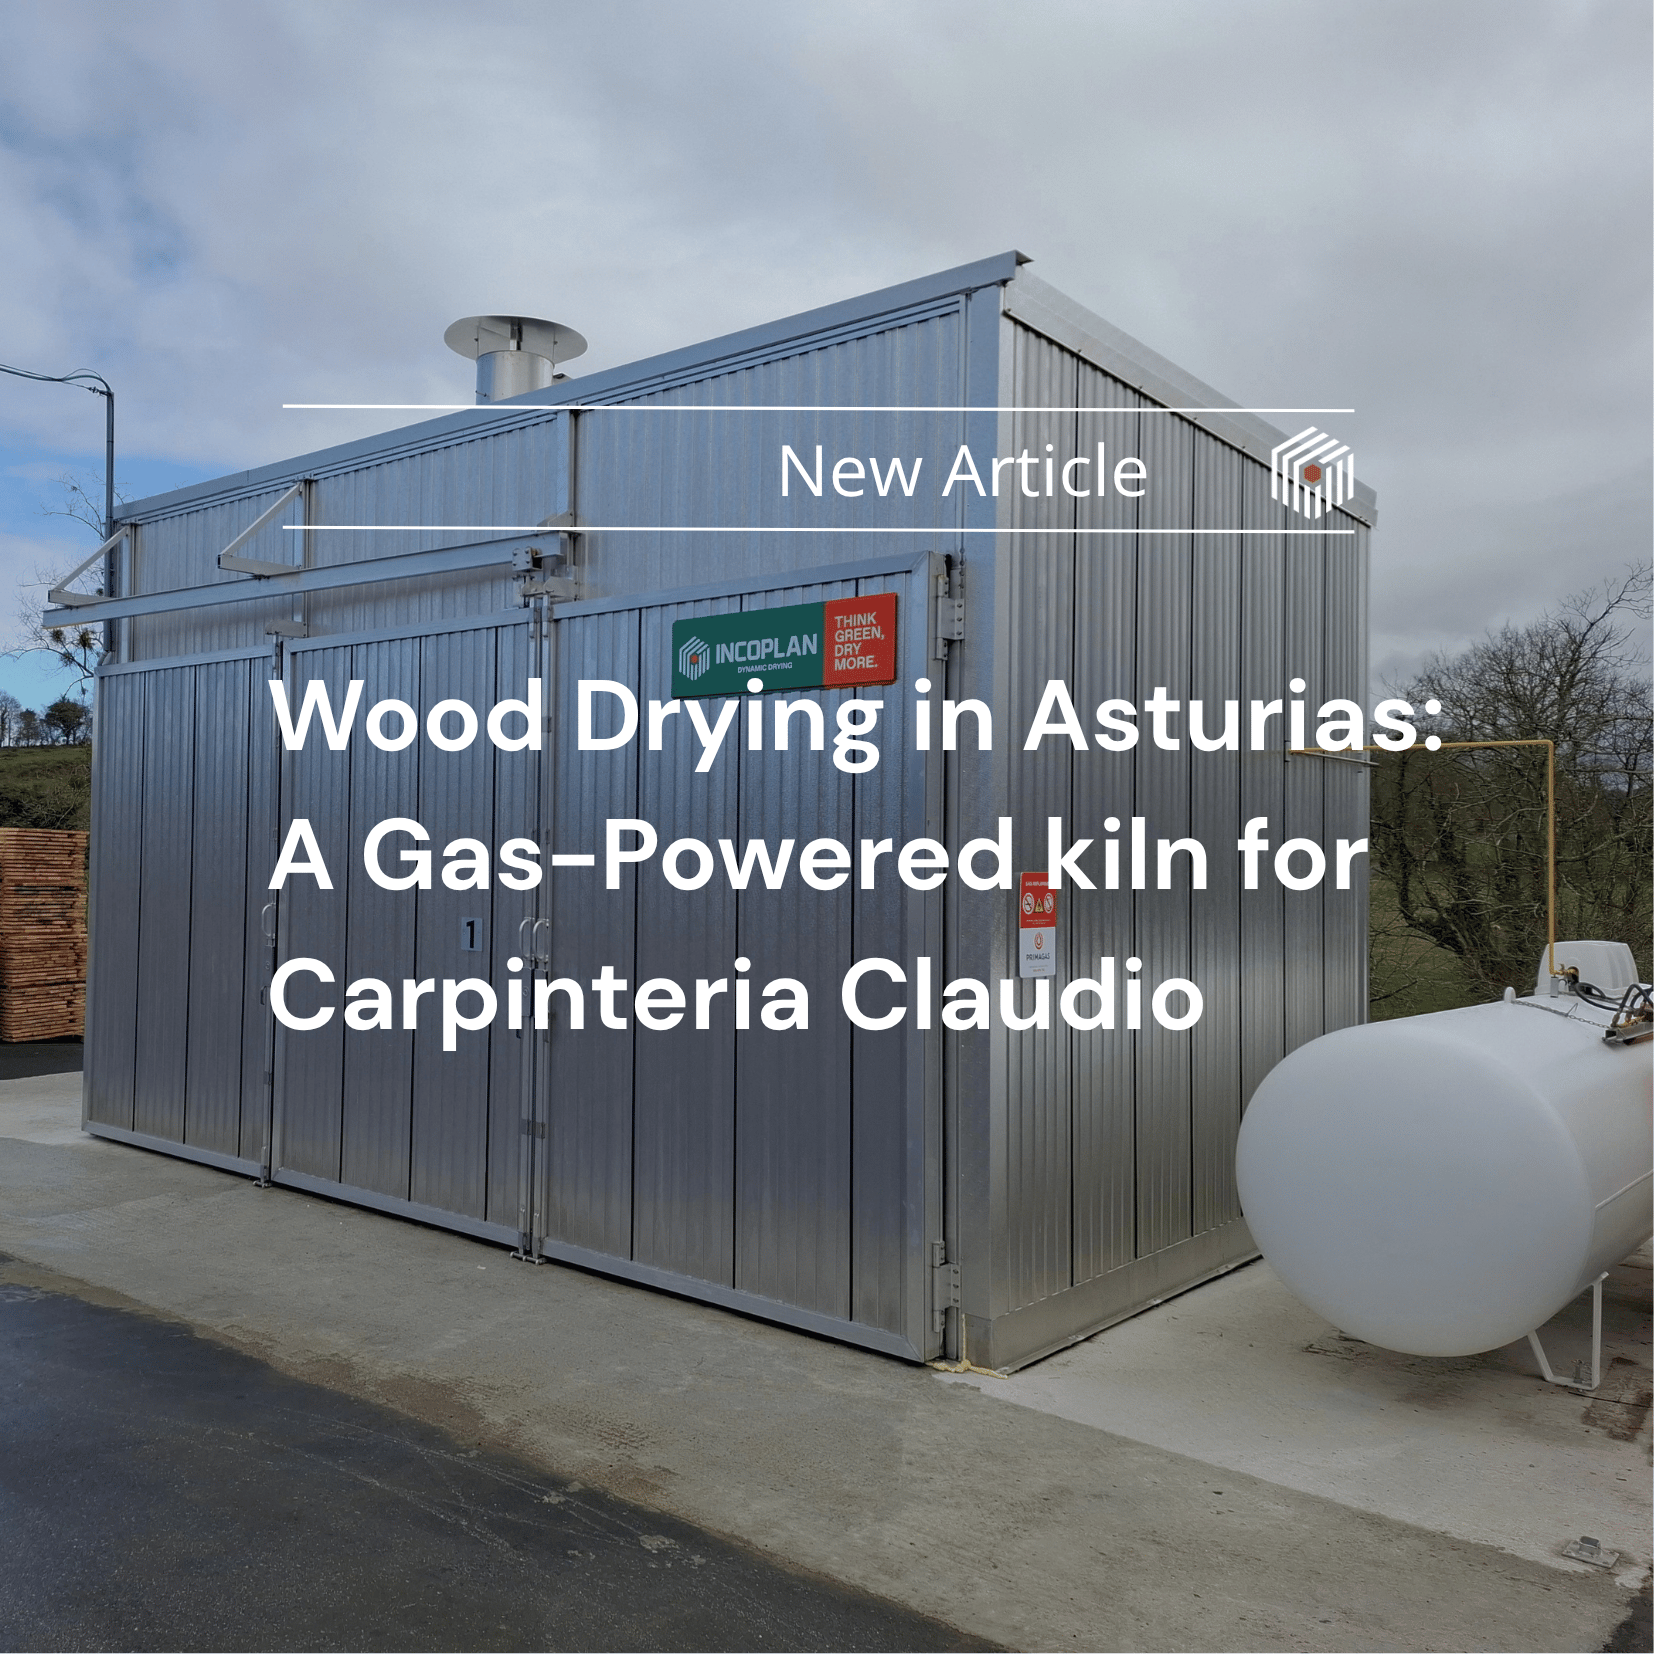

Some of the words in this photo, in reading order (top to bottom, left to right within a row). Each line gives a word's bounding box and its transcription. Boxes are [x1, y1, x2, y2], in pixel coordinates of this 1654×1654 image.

[834, 612, 877, 629] THINK
[834, 626, 885, 643] GREEN,
[716, 633, 818, 665] INCOPLAN
[834, 642, 862, 657] DRY
[737, 663, 767, 674] DYNAMIC
[768, 661, 793, 672] DRYING
[834, 655, 878, 671] MORE.
[466, 919, 475, 949] 1
[1026, 952, 1051, 961] PRIMAGAS
